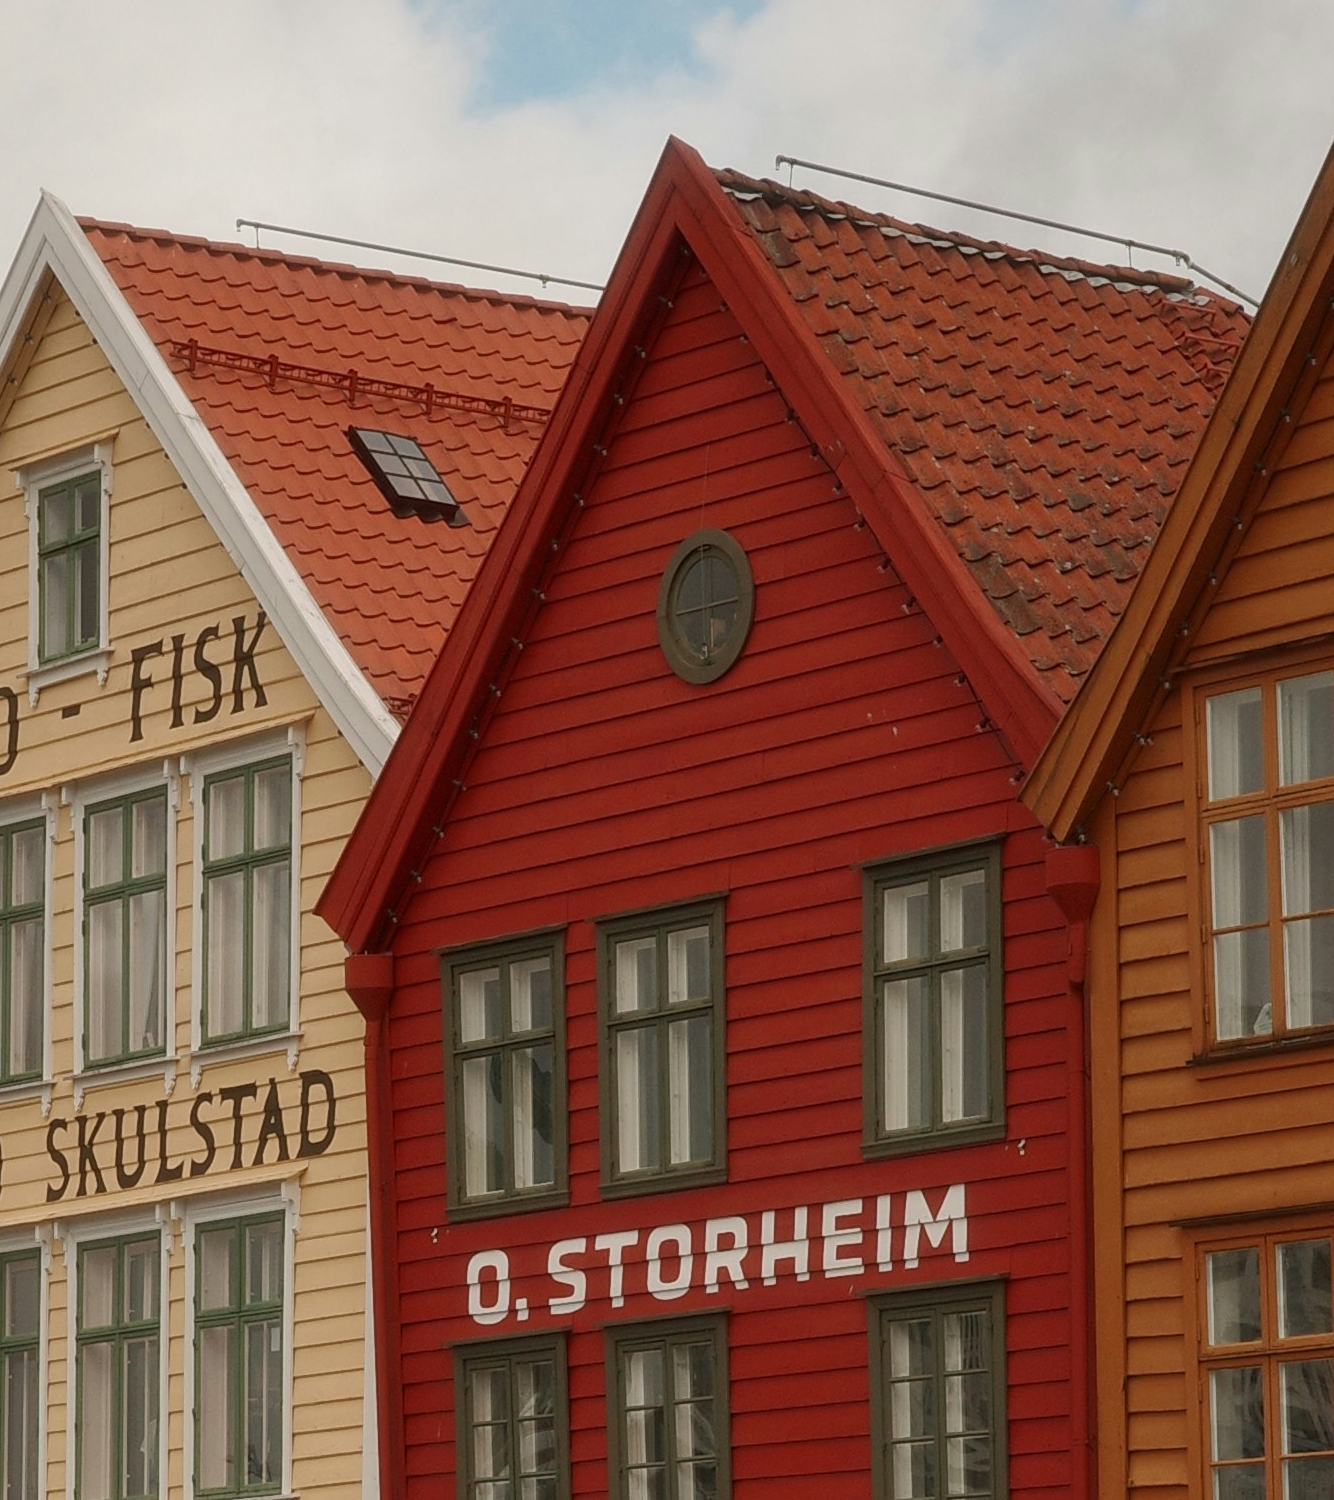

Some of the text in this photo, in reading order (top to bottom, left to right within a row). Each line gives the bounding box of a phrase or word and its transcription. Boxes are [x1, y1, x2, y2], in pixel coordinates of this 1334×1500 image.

[129, 612, 269, 743] FISK
[45, 1069, 338, 1203] SKULSTAD
[466, 1183, 971, 1326] O. STORHEIM
